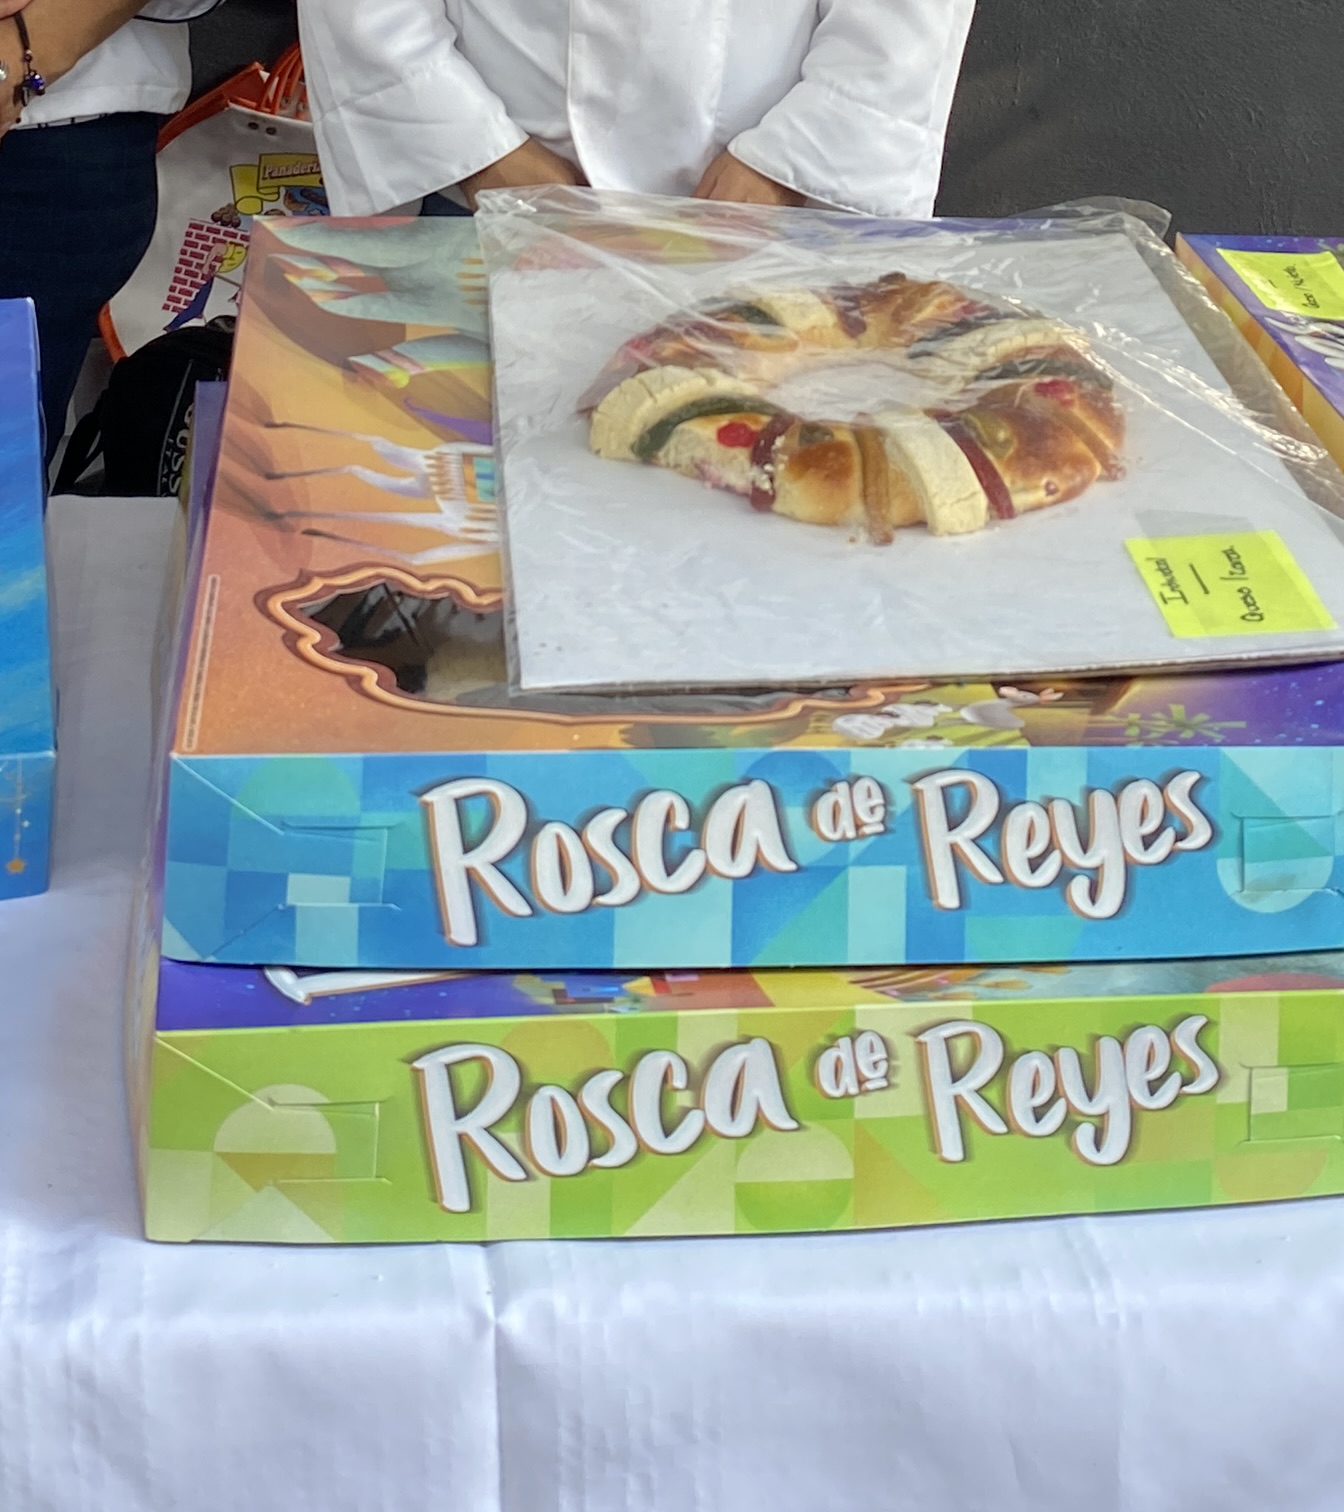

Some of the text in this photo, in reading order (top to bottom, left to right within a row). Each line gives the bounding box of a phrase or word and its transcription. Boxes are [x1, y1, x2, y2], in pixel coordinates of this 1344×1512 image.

[419, 769, 1215, 948] Rosca de Reyes
[412, 1014, 1221, 1214] Rosca de Reyes
